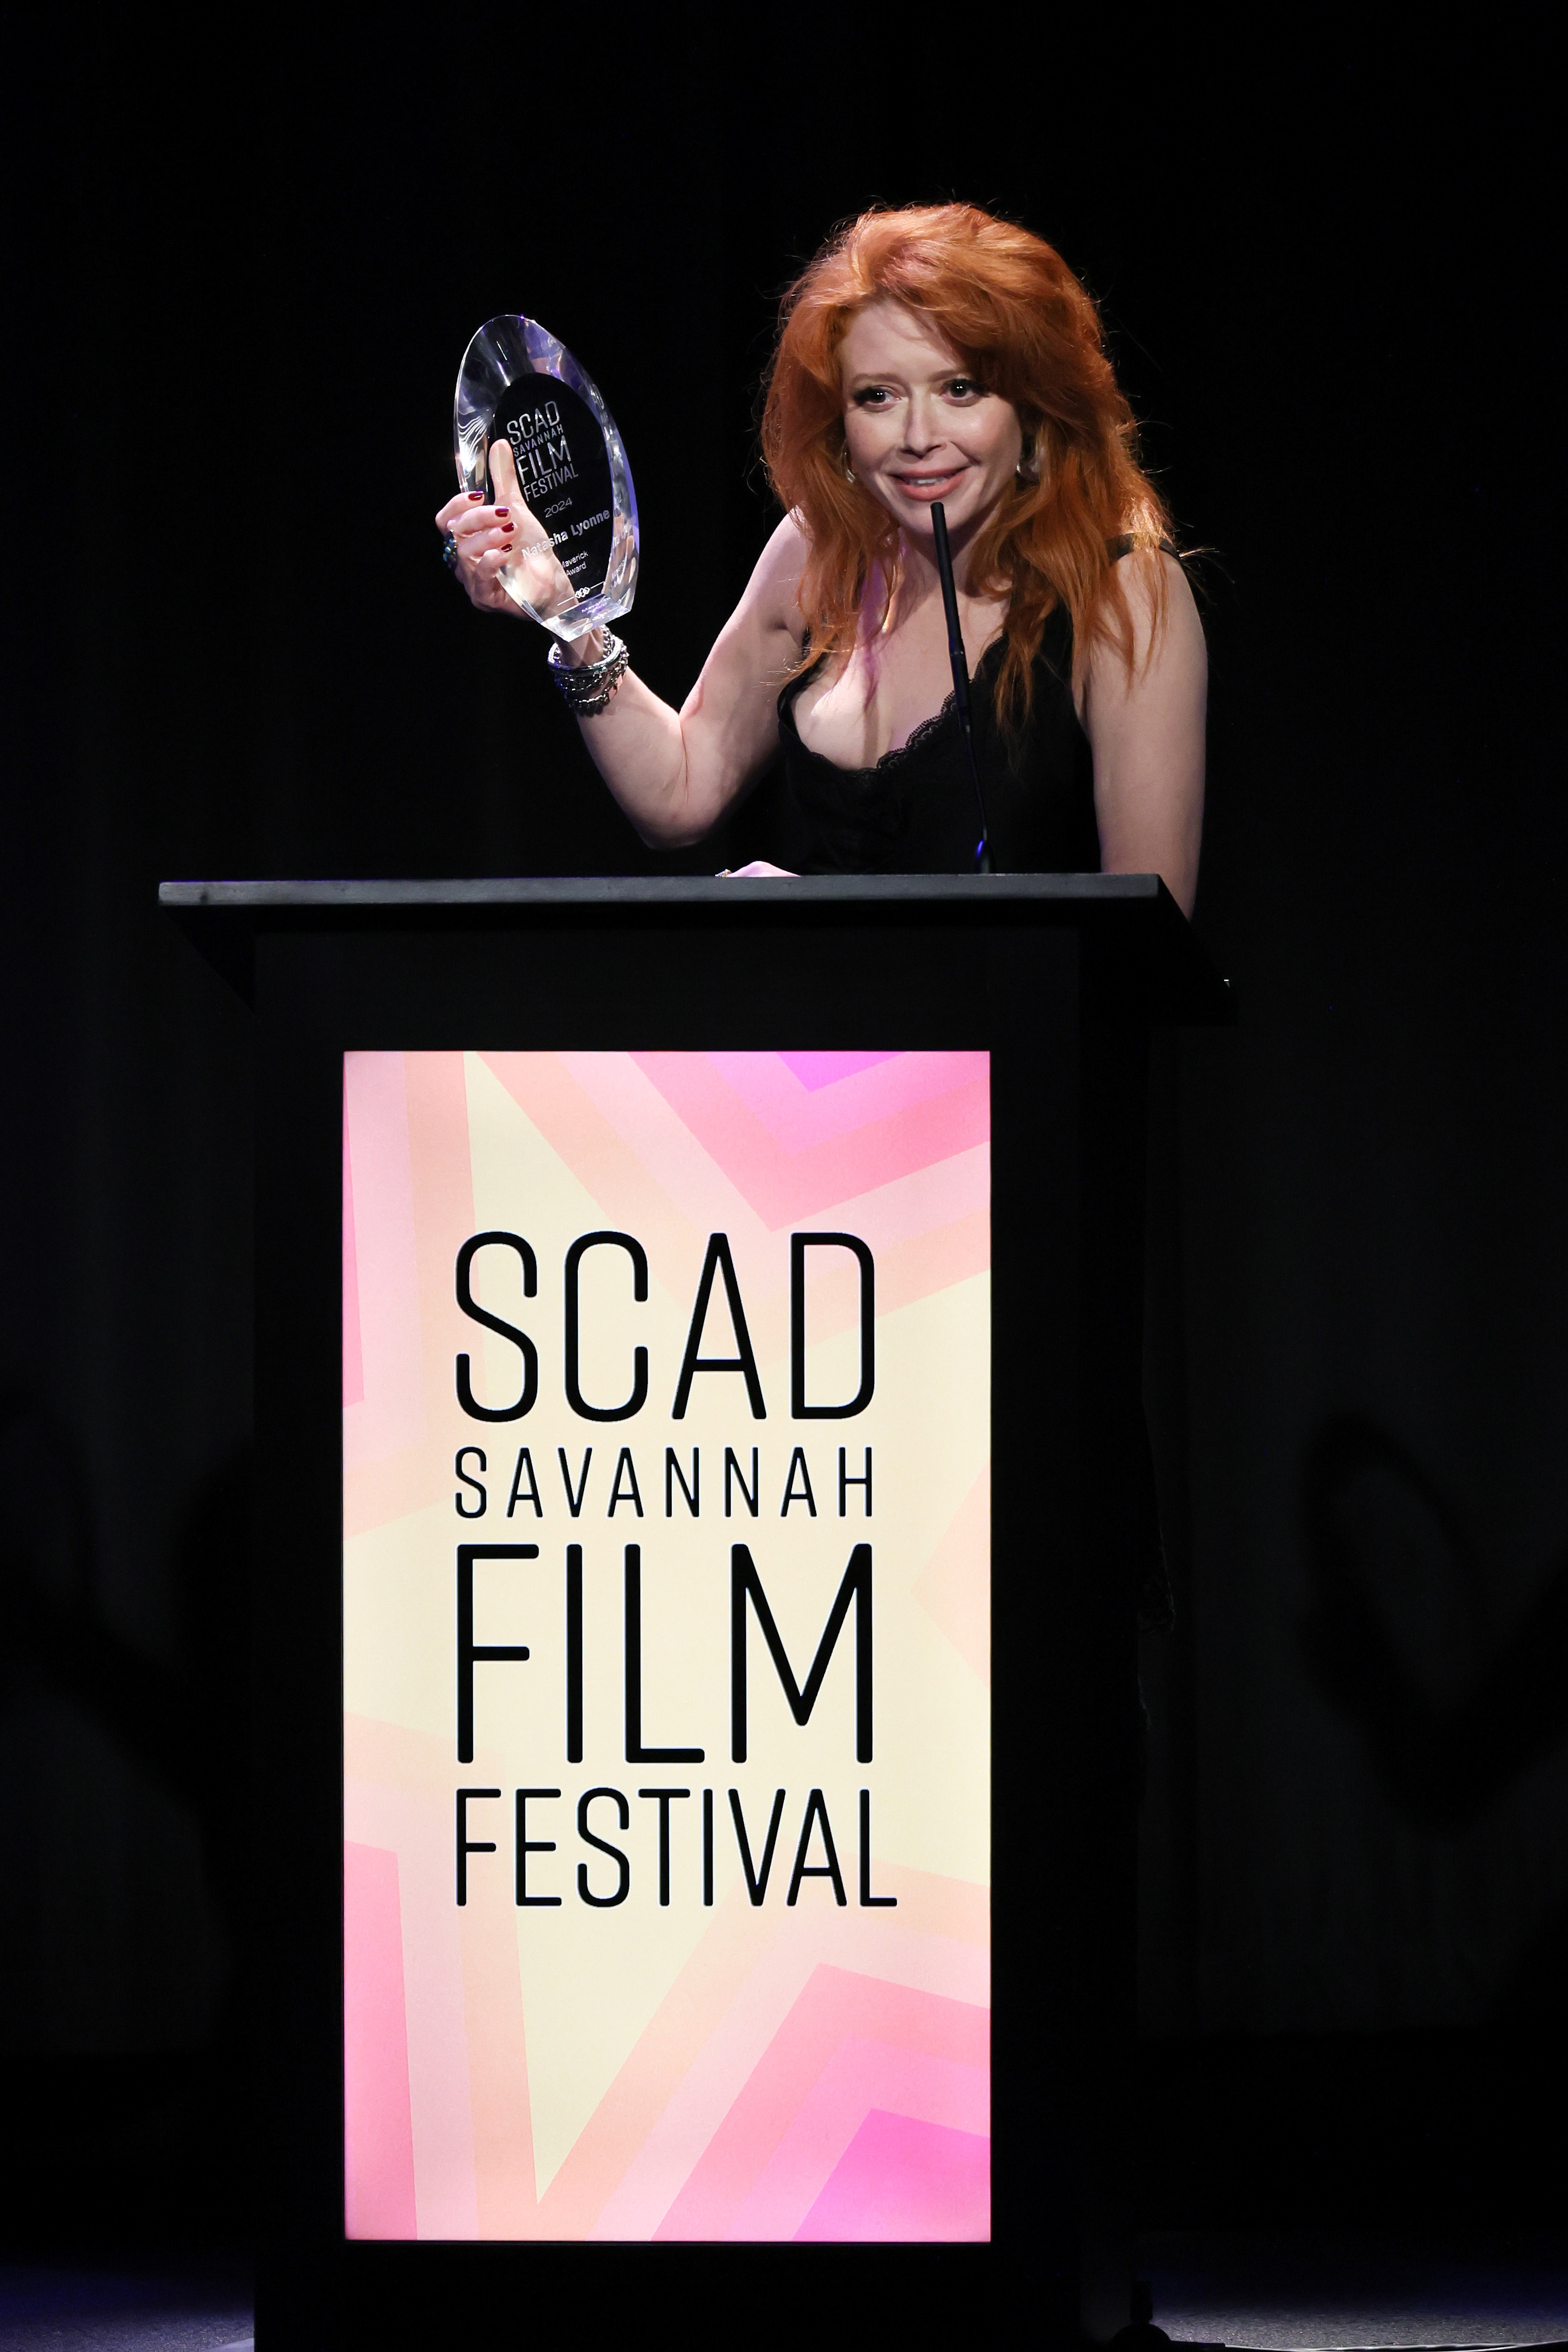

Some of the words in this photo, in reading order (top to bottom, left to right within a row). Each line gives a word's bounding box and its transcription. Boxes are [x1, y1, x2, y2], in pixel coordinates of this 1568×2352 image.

[506, 400, 560, 445] SCAD
[513, 426, 564, 457] SAVANNAH
[516, 436, 572, 485] FILM
[523, 463, 579, 501] FESTIVAL
[544, 497, 573, 518] 2024
[521, 530, 569, 561] Natasha
[570, 510, 610, 536] Lyonne
[565, 562, 587, 576] Award
[457, 1231, 875, 1422] SCAD
[456, 1447, 872, 1518] SAVANNAH
[458, 1544, 873, 1763] FILM
[457, 1788, 897, 1907] FESTIVAL
